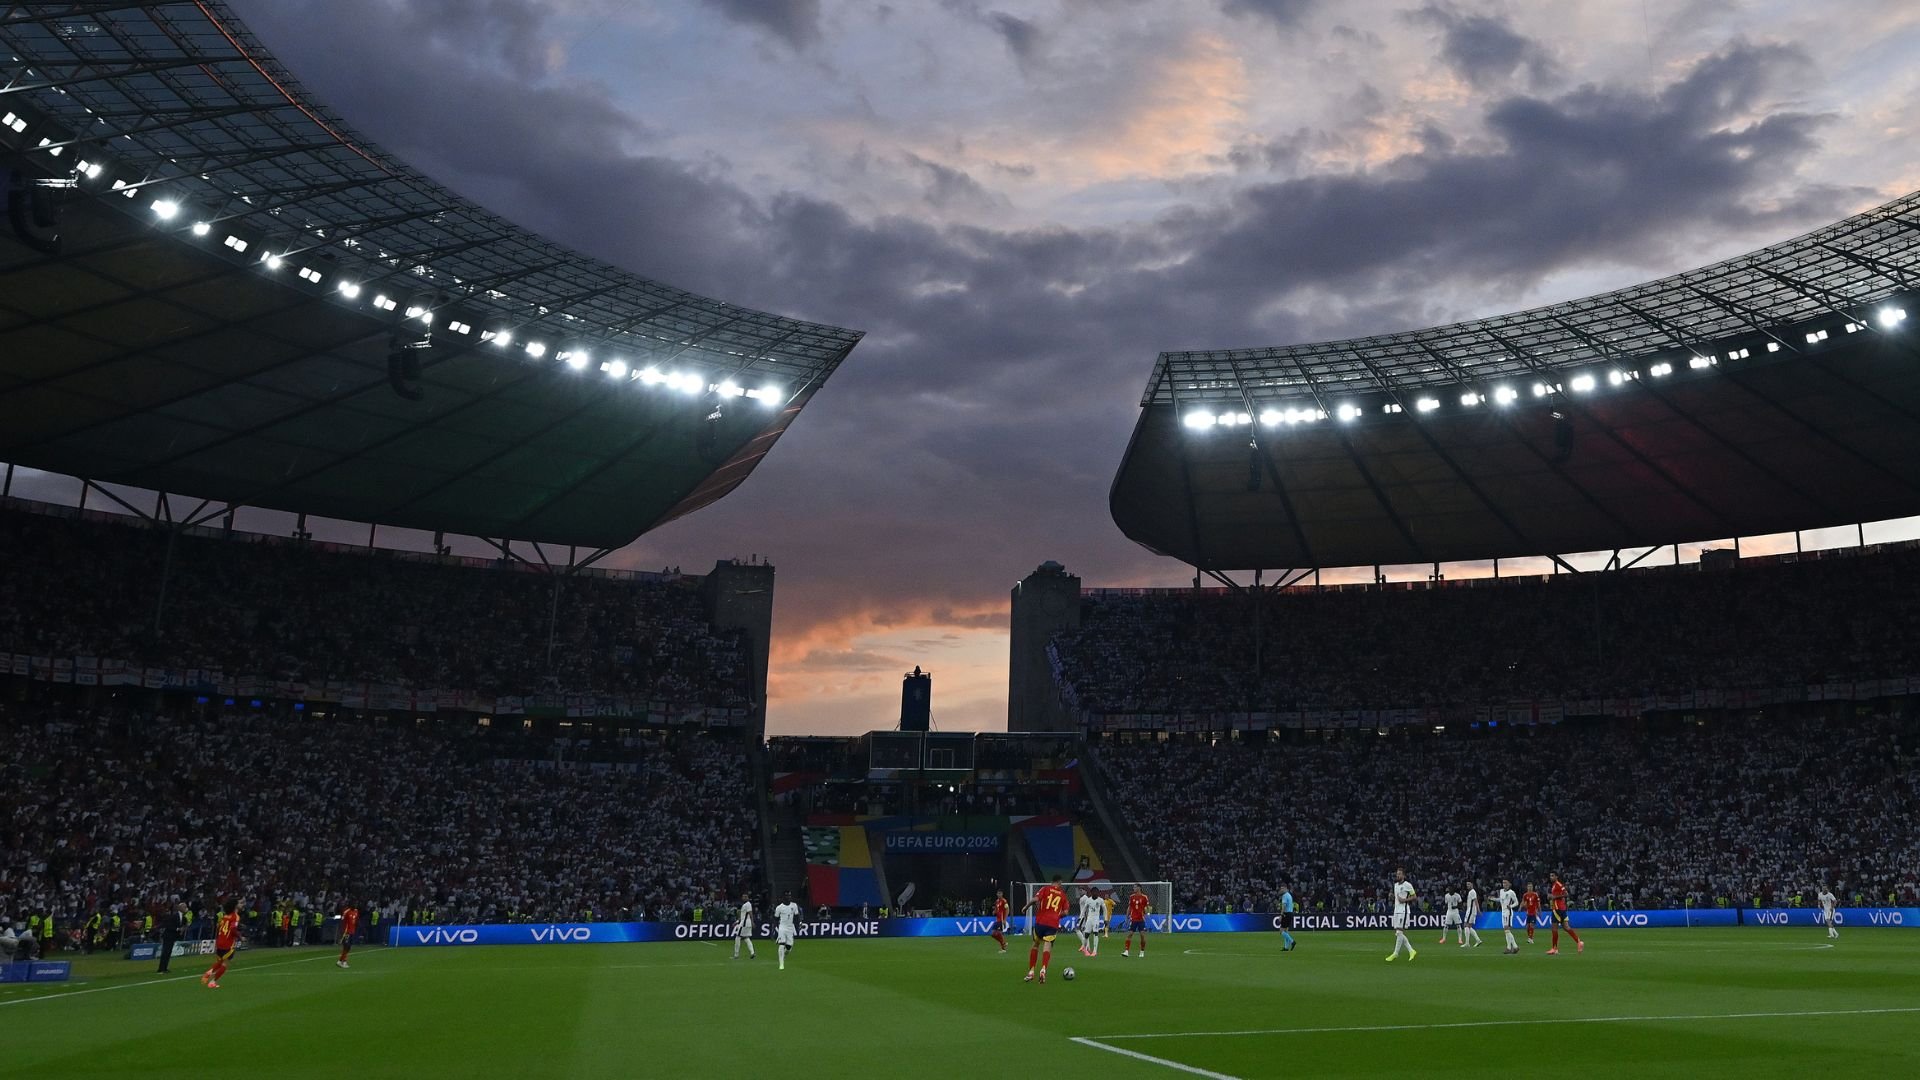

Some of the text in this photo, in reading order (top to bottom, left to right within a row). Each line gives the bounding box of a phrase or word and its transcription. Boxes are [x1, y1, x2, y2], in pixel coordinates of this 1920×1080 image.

[1046, 893, 1061, 911] 14
[1152, 915, 1202, 930] vvo
[1272, 915, 1340, 929] OFICIAL
[1346, 915, 1449, 928] SMARTHONE
[1602, 912, 1648, 926] vivo
[1756, 911, 1789, 924] vivo
[1812, 909, 1844, 924] vio
[1868, 909, 1903, 924] vivo
[416, 927, 478, 943] vivo
[531, 925, 591, 941] vivo
[675, 921, 879, 938] OFFICIA SRTPHONE
